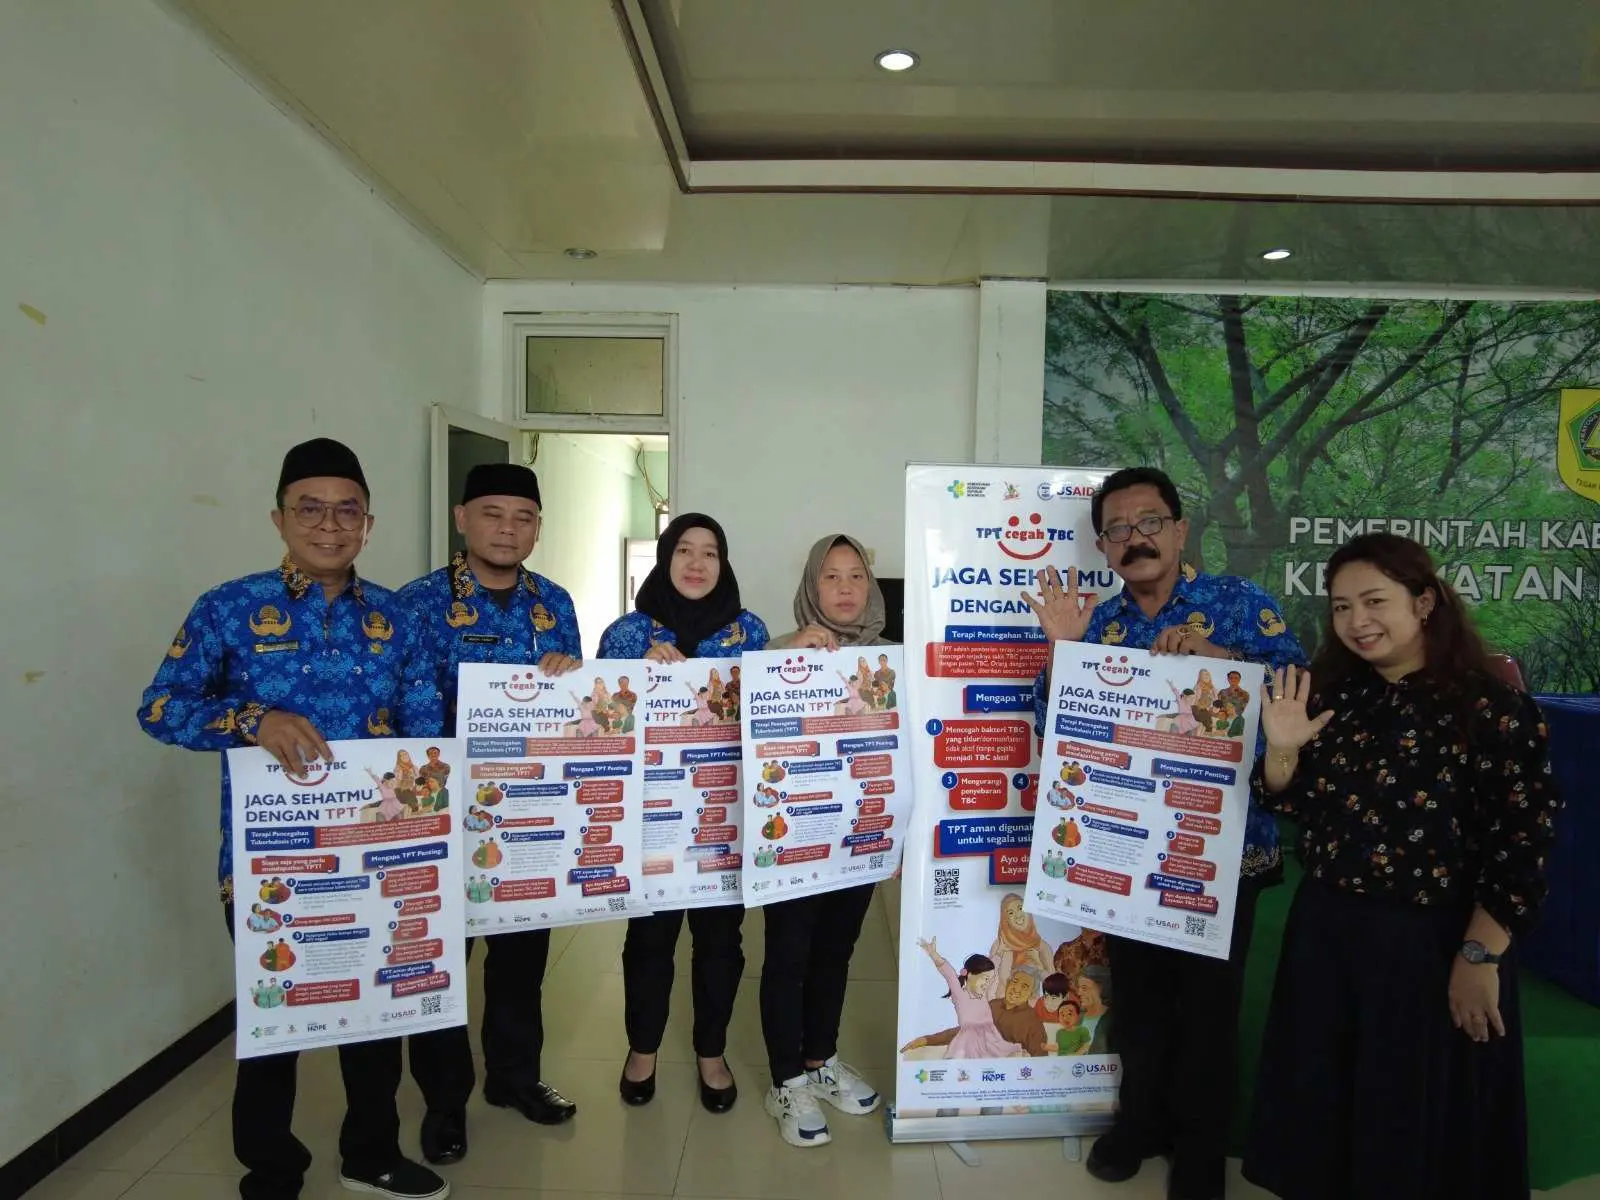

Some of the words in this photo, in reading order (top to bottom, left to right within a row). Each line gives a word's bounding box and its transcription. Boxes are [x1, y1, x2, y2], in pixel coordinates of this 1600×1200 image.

[976, 527, 1002, 540] TPT
[1005, 529, 1044, 542] cegah
[1047, 528, 1074, 541] TBC
[1289, 517, 1526, 548] PEMERINTAH
[932, 567, 992, 588] JAGA
[951, 599, 1031, 614] DENGAN
[951, 630, 976, 640] Terapi
[977, 631, 1021, 640] Pencegahan
[767, 666, 782, 674] TPT
[784, 666, 806, 674] cegah
[807, 664, 824, 672] TBC
[1082, 662, 1100, 670] TPT
[1102, 665, 1128, 674] cegah
[1130, 666, 1151, 677] TBC
[489, 682, 508, 690] TPT
[537, 682, 555, 690] TBC
[750, 691, 781, 704] JAGA
[784, 688, 843, 700] SEHATMU
[976, 693, 1016, 704] Mengapa
[1059, 685, 1094, 700] JAGA
[1098, 690, 1171, 710] SEHATMU
[467, 708, 504, 721] JAGA
[508, 706, 575, 718] SEHATMU
[751, 704, 805, 716] DENGAN
[809, 702, 832, 712] TPT
[1058, 699, 1120, 718] DENGAN
[1124, 709, 1154, 722] TPT
[653, 712, 678, 721] TPT
[468, 722, 532, 733] DENGAN
[536, 722, 562, 732] TPT
[266, 764, 284, 772] TP
[324, 760, 347, 772] TBC
[948, 776, 952, 784] 3
[244, 794, 287, 809] JAGA
[292, 789, 373, 806] SEHATMU
[246, 810, 320, 822] DENGAN
[325, 807, 358, 820] TPT
[947, 825, 968, 834] TPT
[958, 836, 984, 844] untuk
[986, 836, 1015, 845] segala
[1000, 855, 1018, 864] Ayo
[392, 1010, 417, 1018] USAID
[1086, 1064, 1118, 1072] USAID
[982, 1073, 1006, 1082] HOPE
